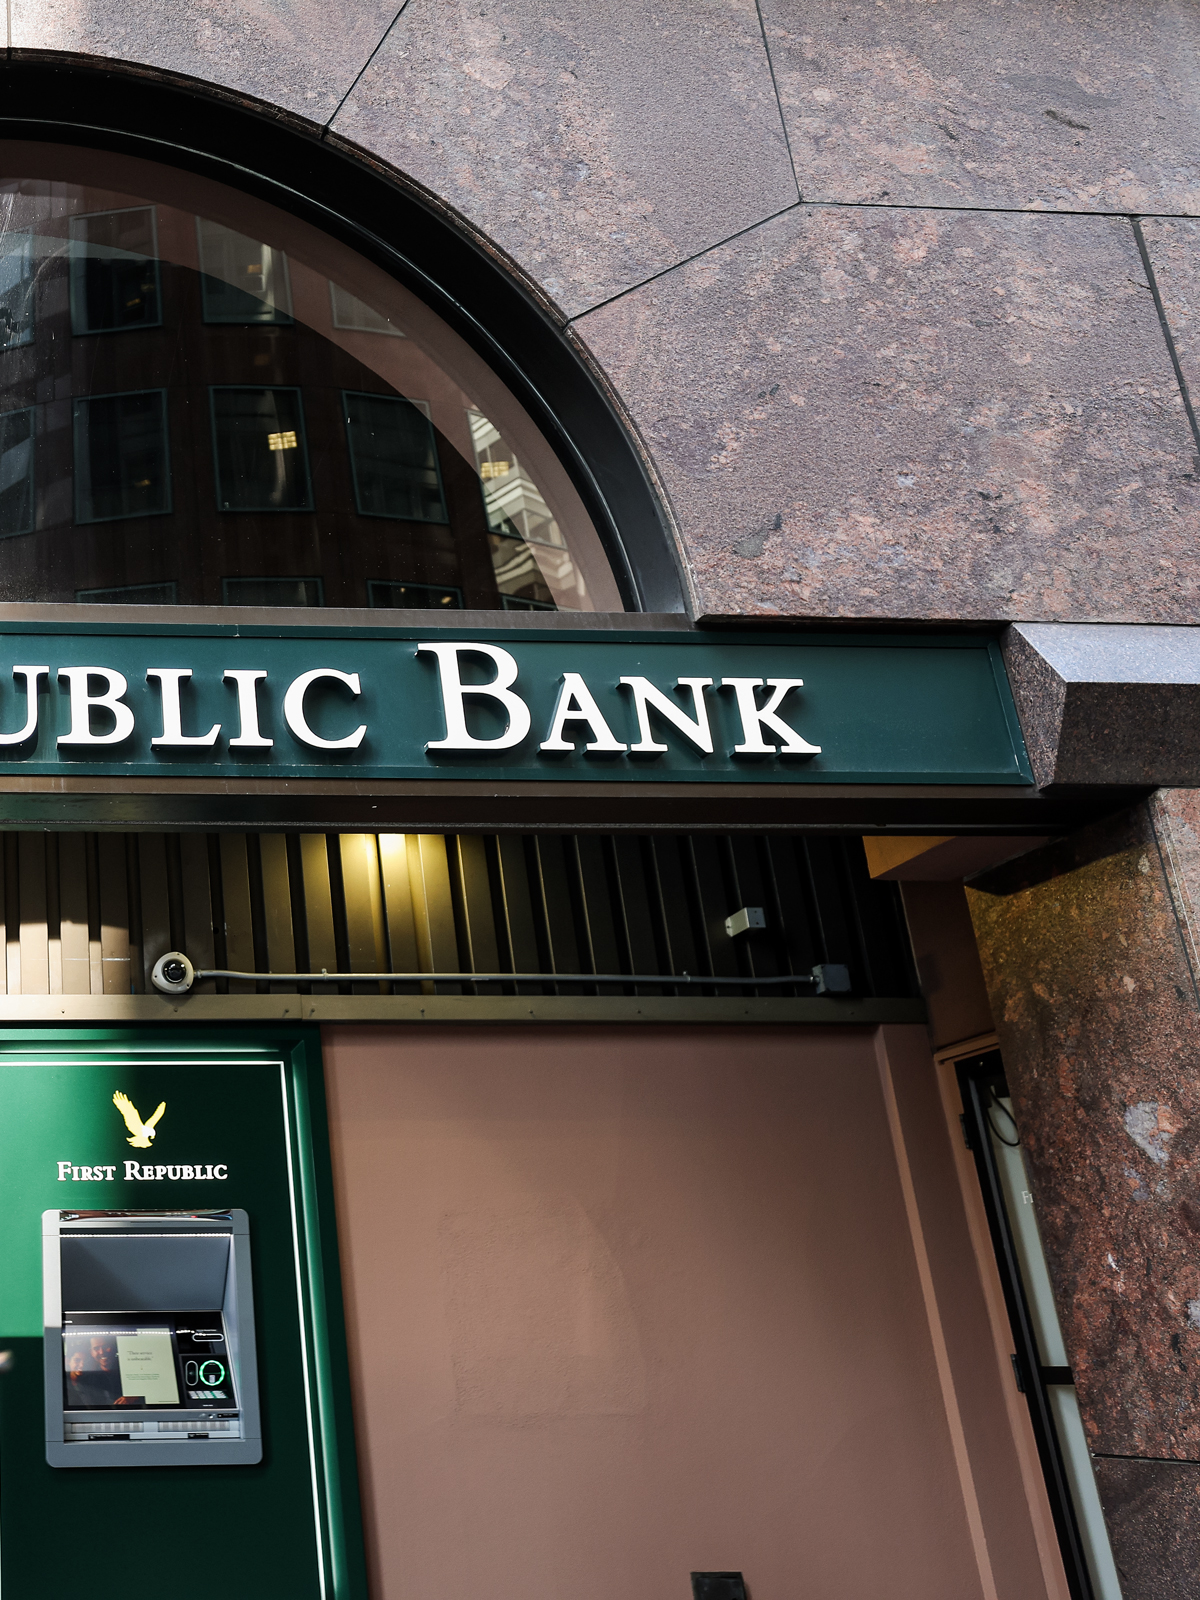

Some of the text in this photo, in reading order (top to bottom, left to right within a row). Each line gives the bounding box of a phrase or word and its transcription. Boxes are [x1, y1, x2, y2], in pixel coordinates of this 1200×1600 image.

[415, 641, 822, 755] BANK
[57, 1160, 228, 1181] FIRST REPUBLIC
